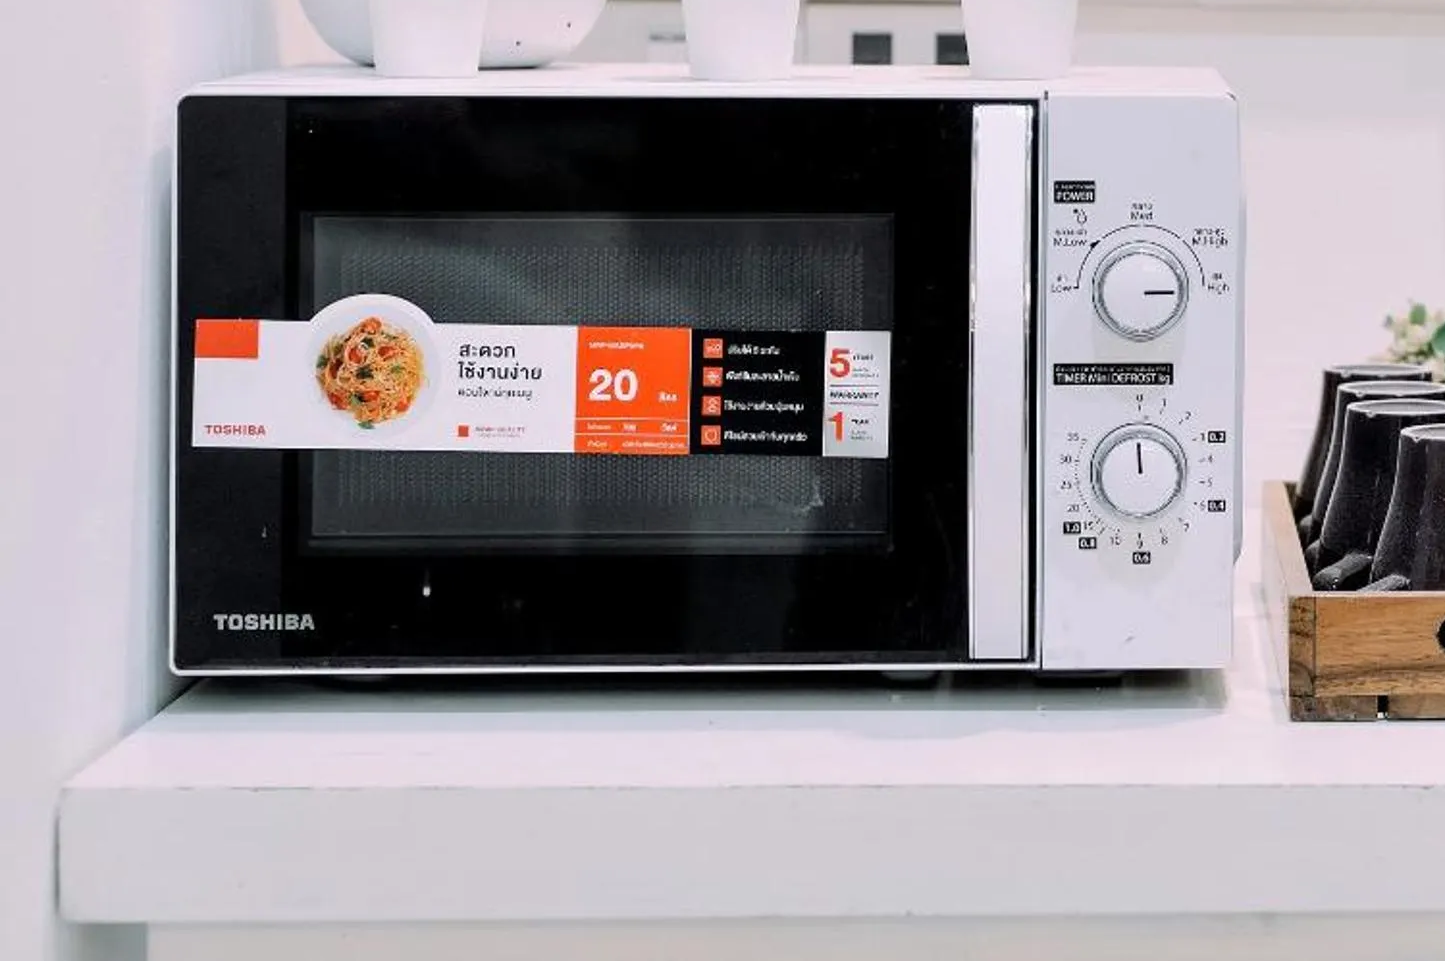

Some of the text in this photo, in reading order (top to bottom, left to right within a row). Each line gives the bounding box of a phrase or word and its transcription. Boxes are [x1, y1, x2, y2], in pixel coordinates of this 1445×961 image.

[830, 348, 851, 378] 5
[589, 369, 638, 401] 20
[204, 424, 266, 436] TOSHIBA
[828, 412, 843, 442] 1
[213, 614, 315, 630] TOSHIBA
